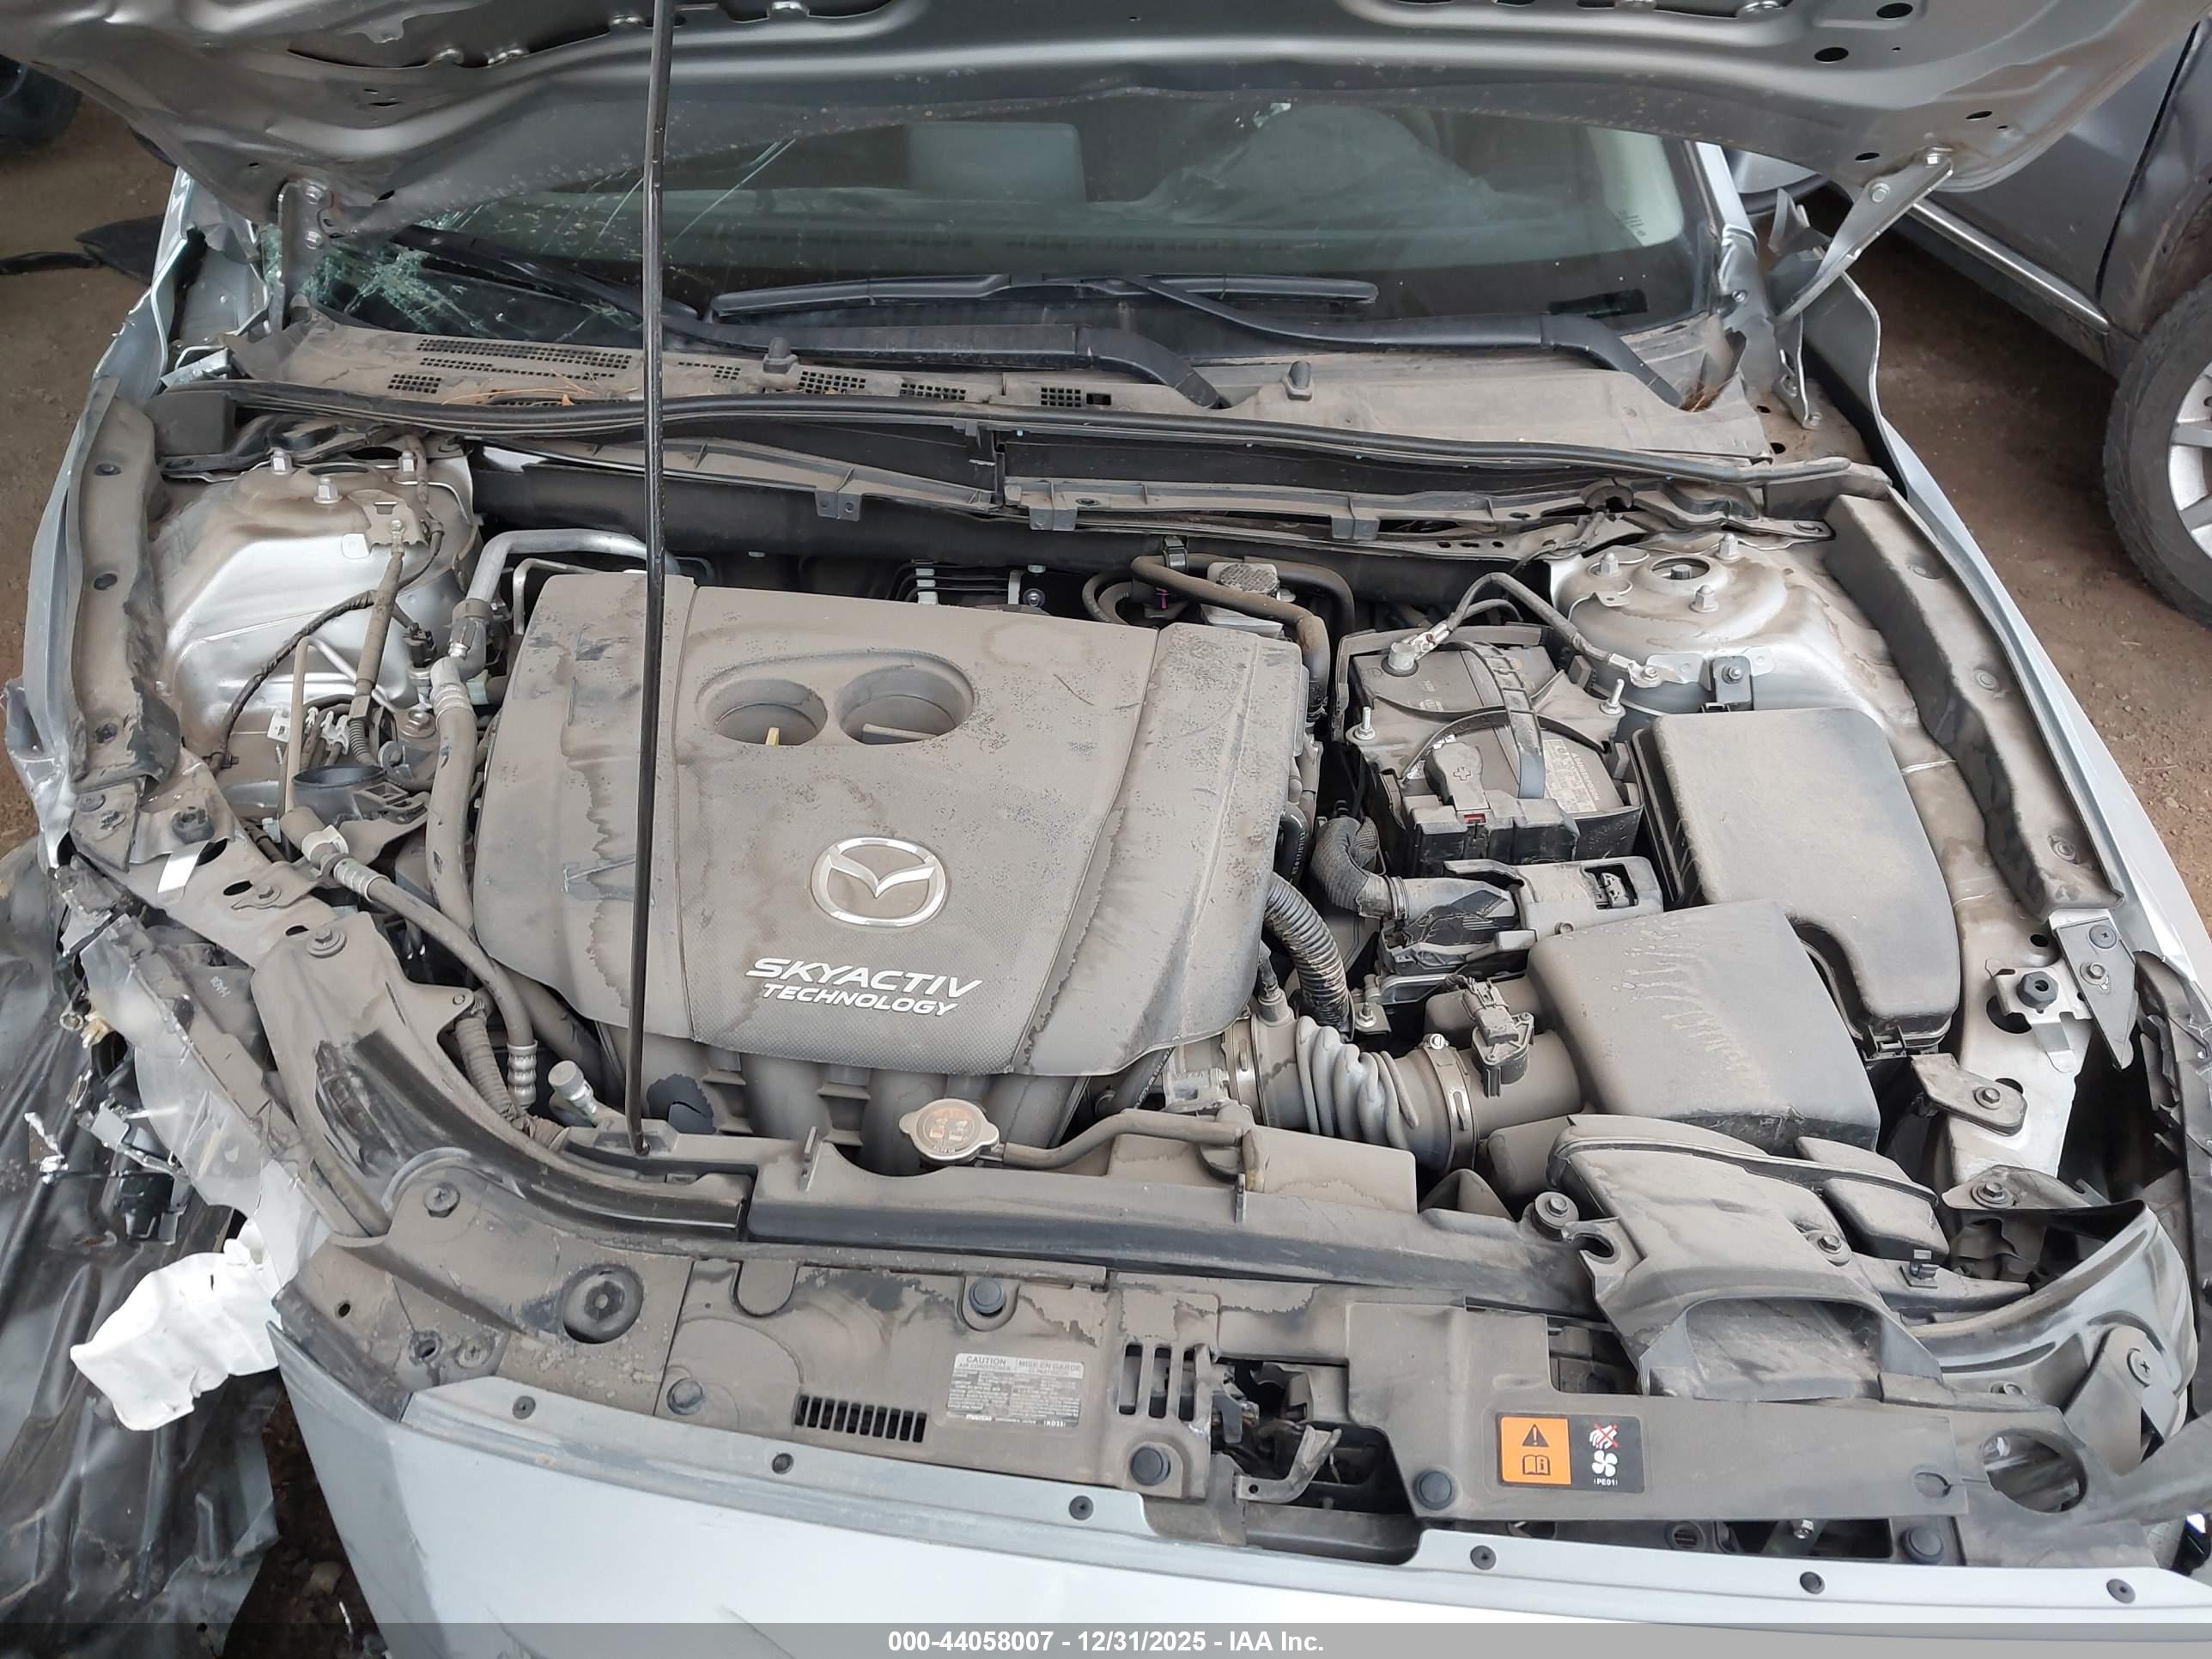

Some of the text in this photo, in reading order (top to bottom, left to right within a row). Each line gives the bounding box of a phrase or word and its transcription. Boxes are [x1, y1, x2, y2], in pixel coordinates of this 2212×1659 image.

[745, 957, 982, 999] SKYACTIV
[763, 983, 959, 1017] TECHNOLOGY
[966, 1356, 1006, 1365] CAUTION
[1018, 1359, 1036, 1368] MISE
[1052, 1362, 1080, 1371] GARDE
[1593, 1477, 1619, 1486] (PE01)
